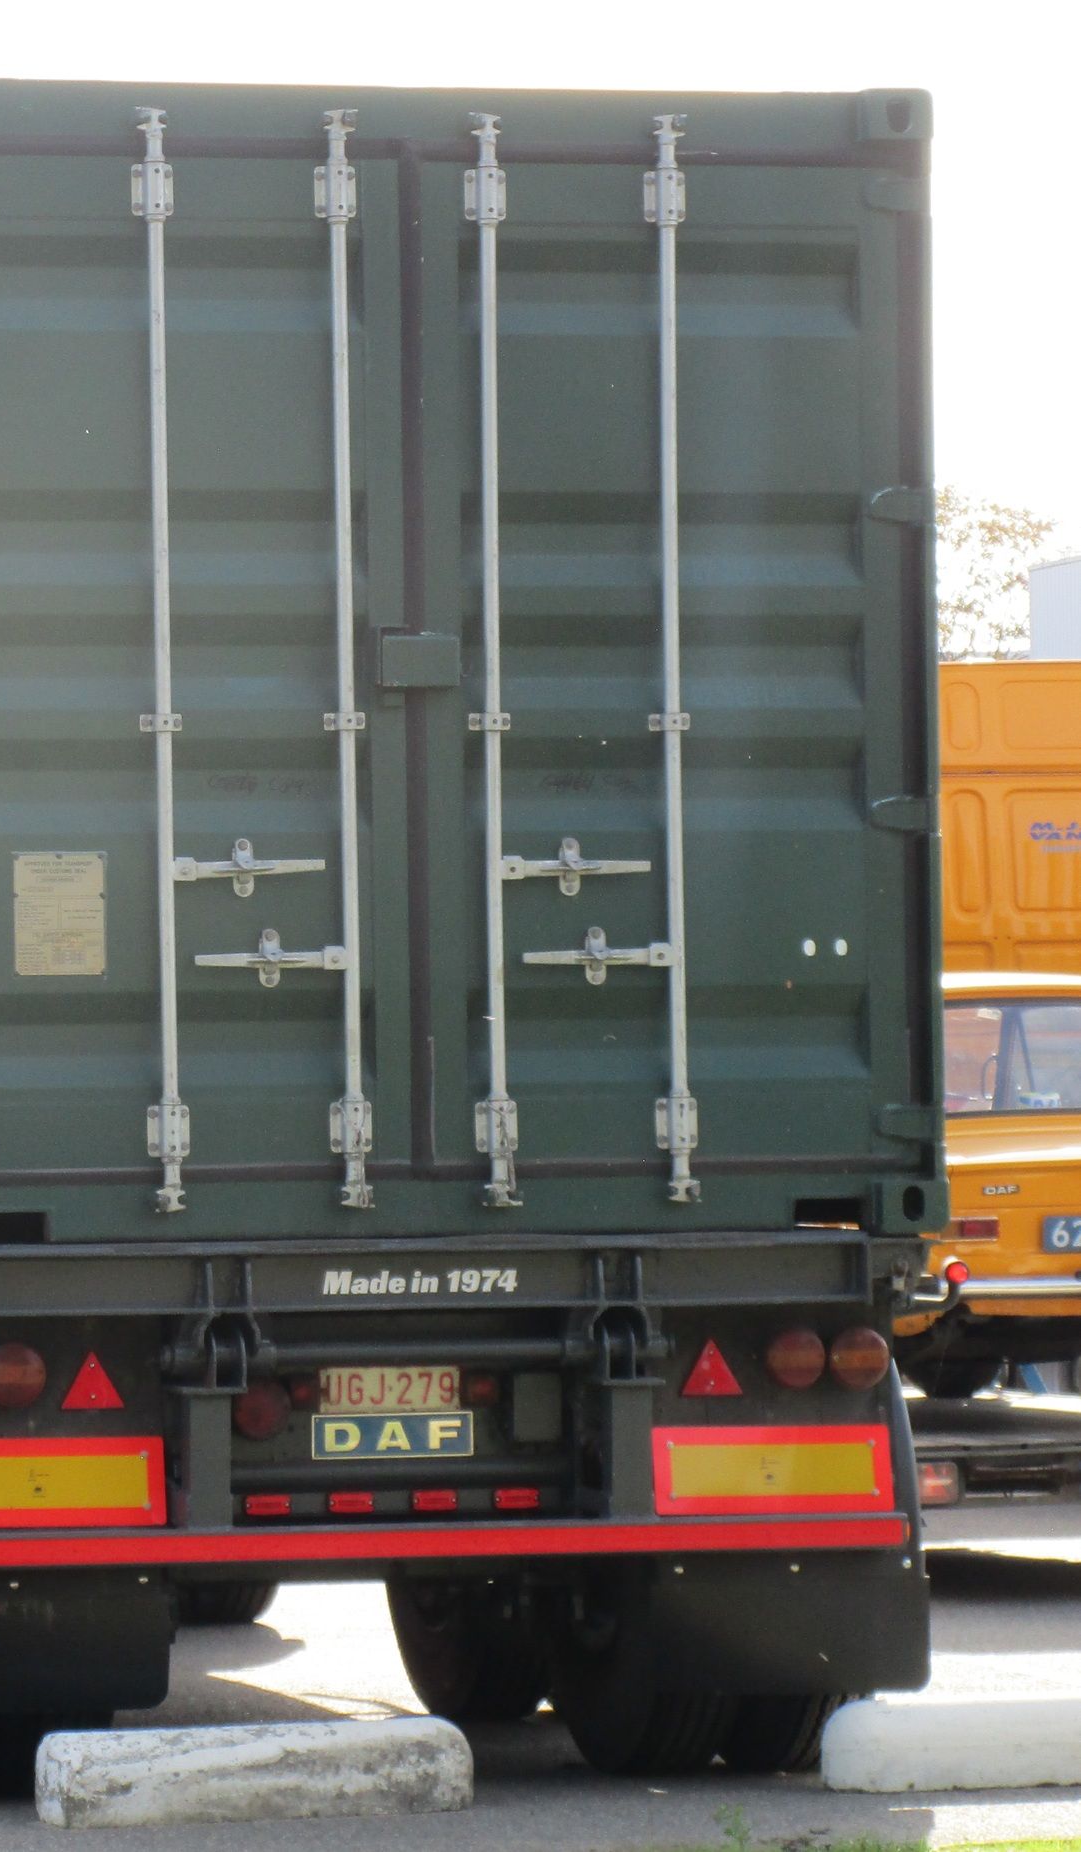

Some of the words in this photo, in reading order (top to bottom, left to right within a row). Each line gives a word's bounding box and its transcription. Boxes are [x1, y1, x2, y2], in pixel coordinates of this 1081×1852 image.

[982, 1185, 1018, 1195] DAF
[322, 1270, 407, 1295] Made
[411, 1271, 439, 1293] in
[447, 1269, 519, 1293] 1974
[324, 1420, 462, 1453] DAF
